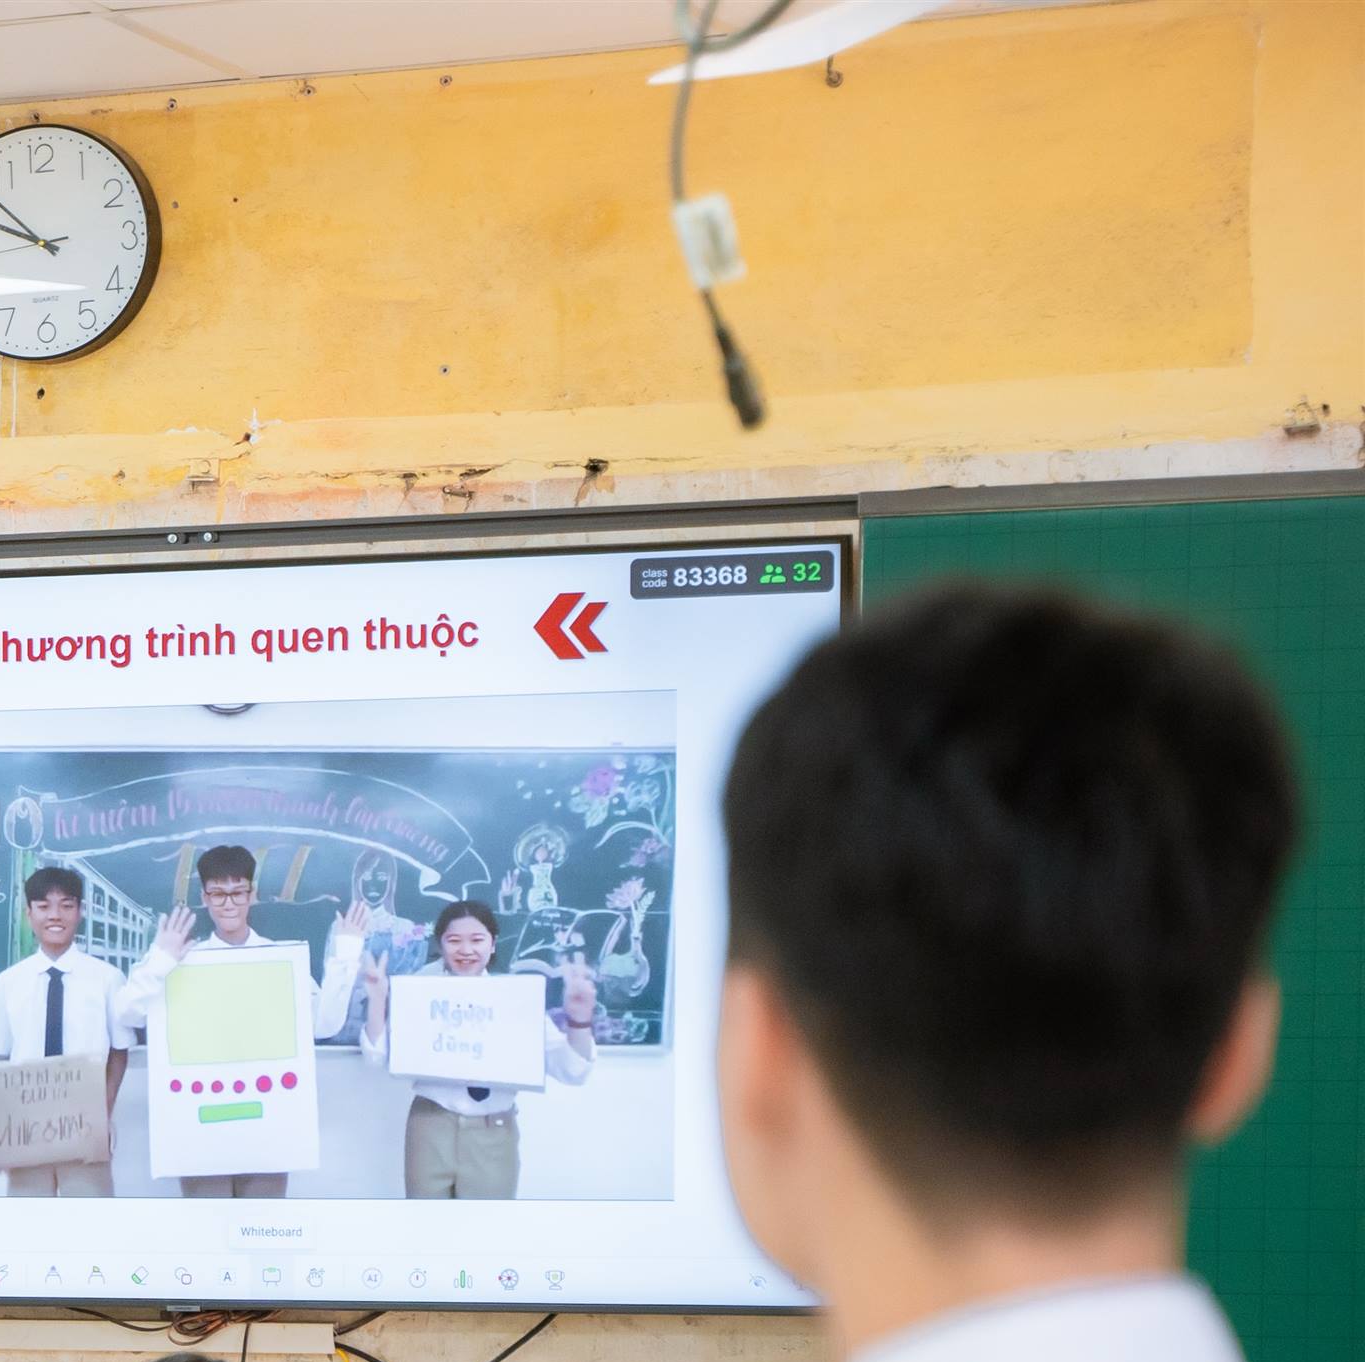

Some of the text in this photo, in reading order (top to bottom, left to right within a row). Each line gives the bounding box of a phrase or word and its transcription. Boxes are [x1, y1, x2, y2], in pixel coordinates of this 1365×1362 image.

[27, 143, 55, 174] 12
[78, 151, 85, 180] 1
[103, 178, 124, 208] 2
[121, 219, 138, 250] 3
[105, 264, 124, 294] 4
[36, 313, 56, 343] 6
[78, 299, 97, 330] 5
[641, 568, 668, 578] class
[641, 578, 667, 588] code
[673, 562, 822, 587] 83368 32
[145, 623, 237, 659] trình
[250, 621, 350, 663] quen
[363, 613, 480, 658] thuộc
[240, 1226, 303, 1237] Whiteboard
